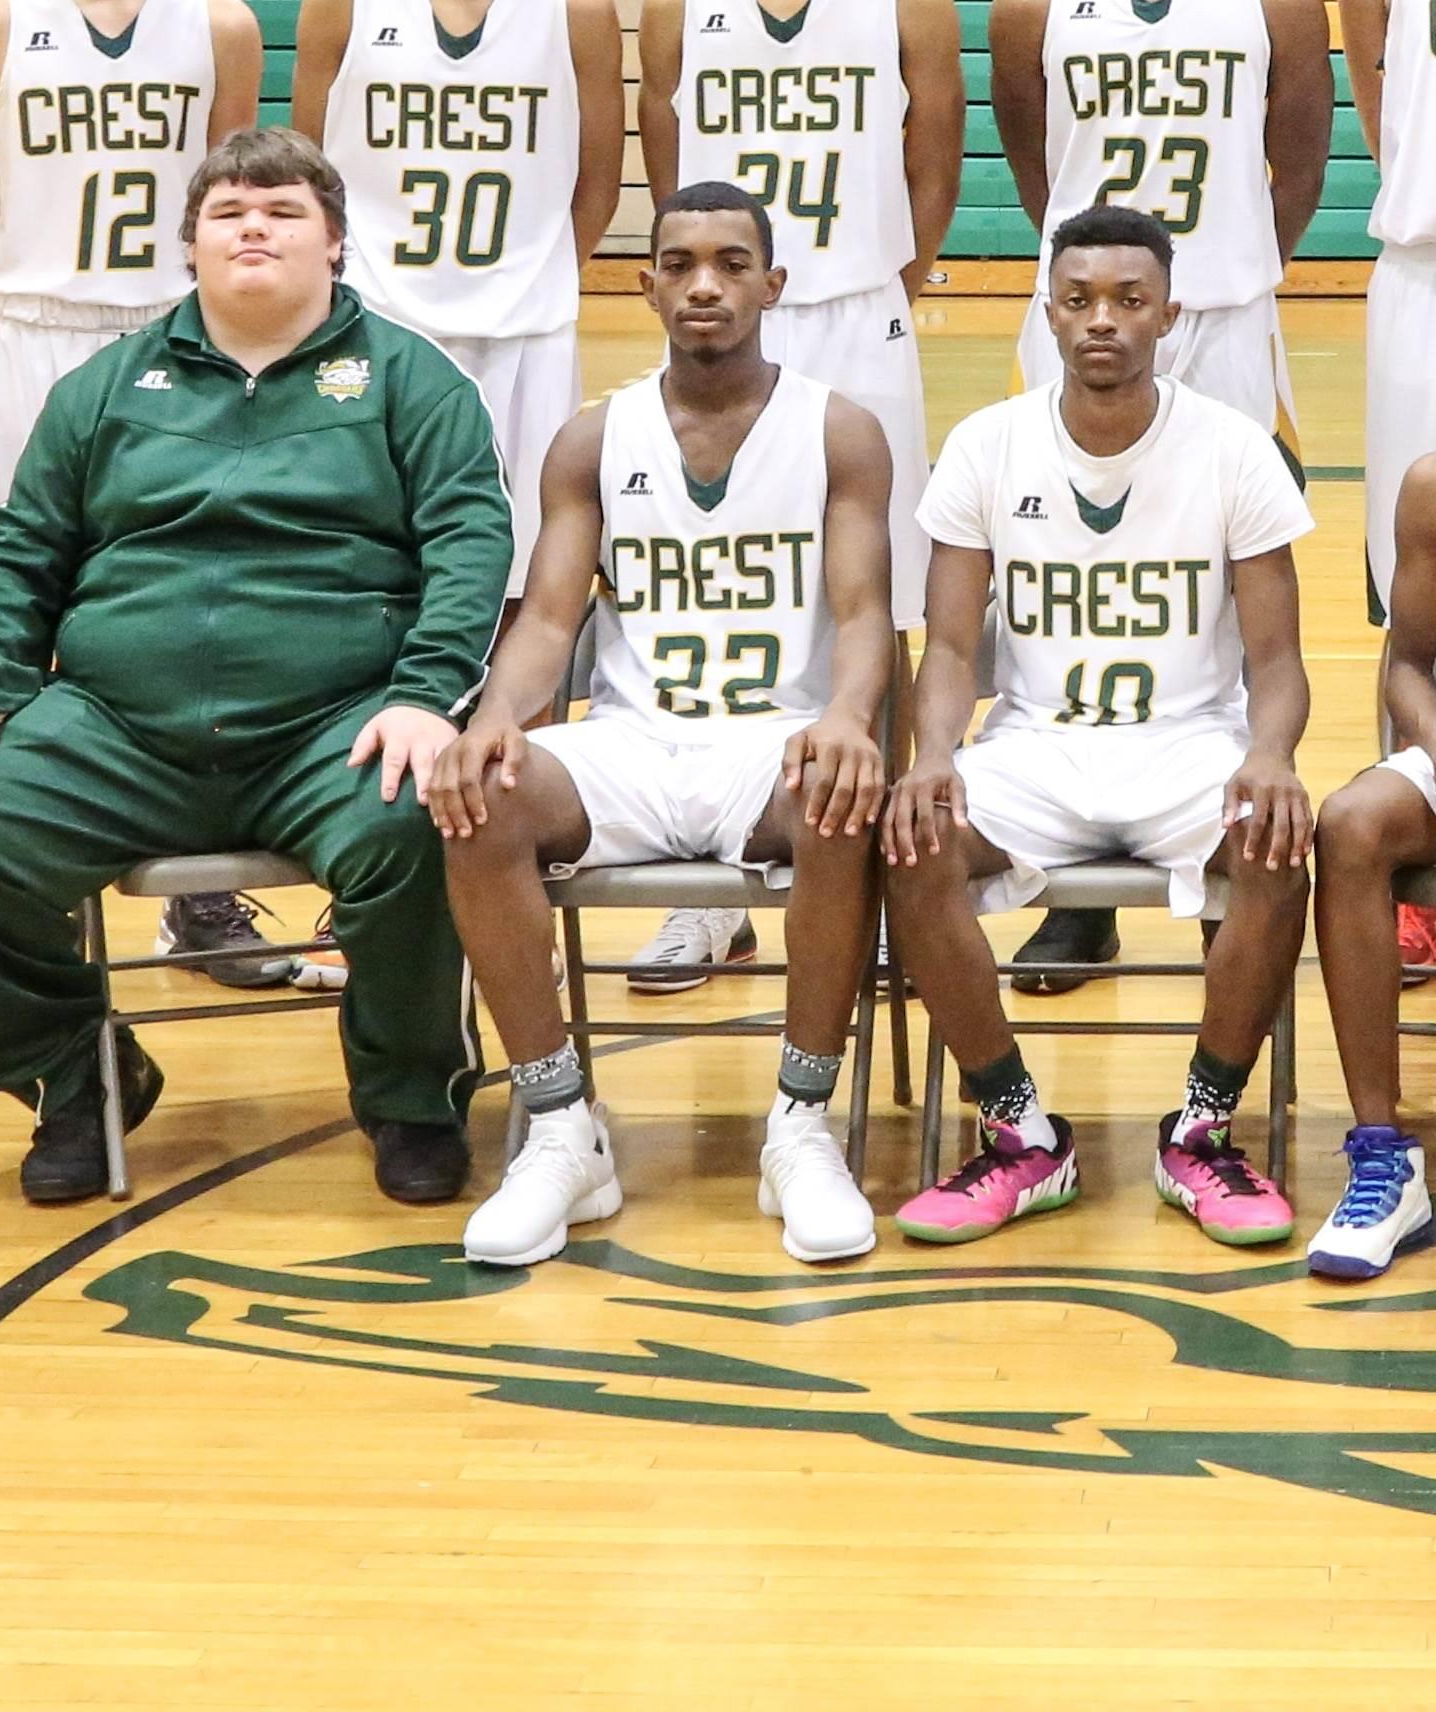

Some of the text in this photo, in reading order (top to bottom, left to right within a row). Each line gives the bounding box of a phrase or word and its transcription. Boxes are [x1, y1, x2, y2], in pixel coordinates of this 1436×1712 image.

[18, 83, 200, 156] CREST
[365, 83, 548, 153] CREST
[694, 65, 875, 134] CREST
[1063, 49, 1246, 121] CREST
[76, 170, 157, 272] 12
[393, 168, 514, 268] 30
[1094, 135, 1210, 235] 23
[611, 531, 814, 614] CREST
[1005, 558, 1212, 638] CREST
[652, 631, 782, 720] 22
